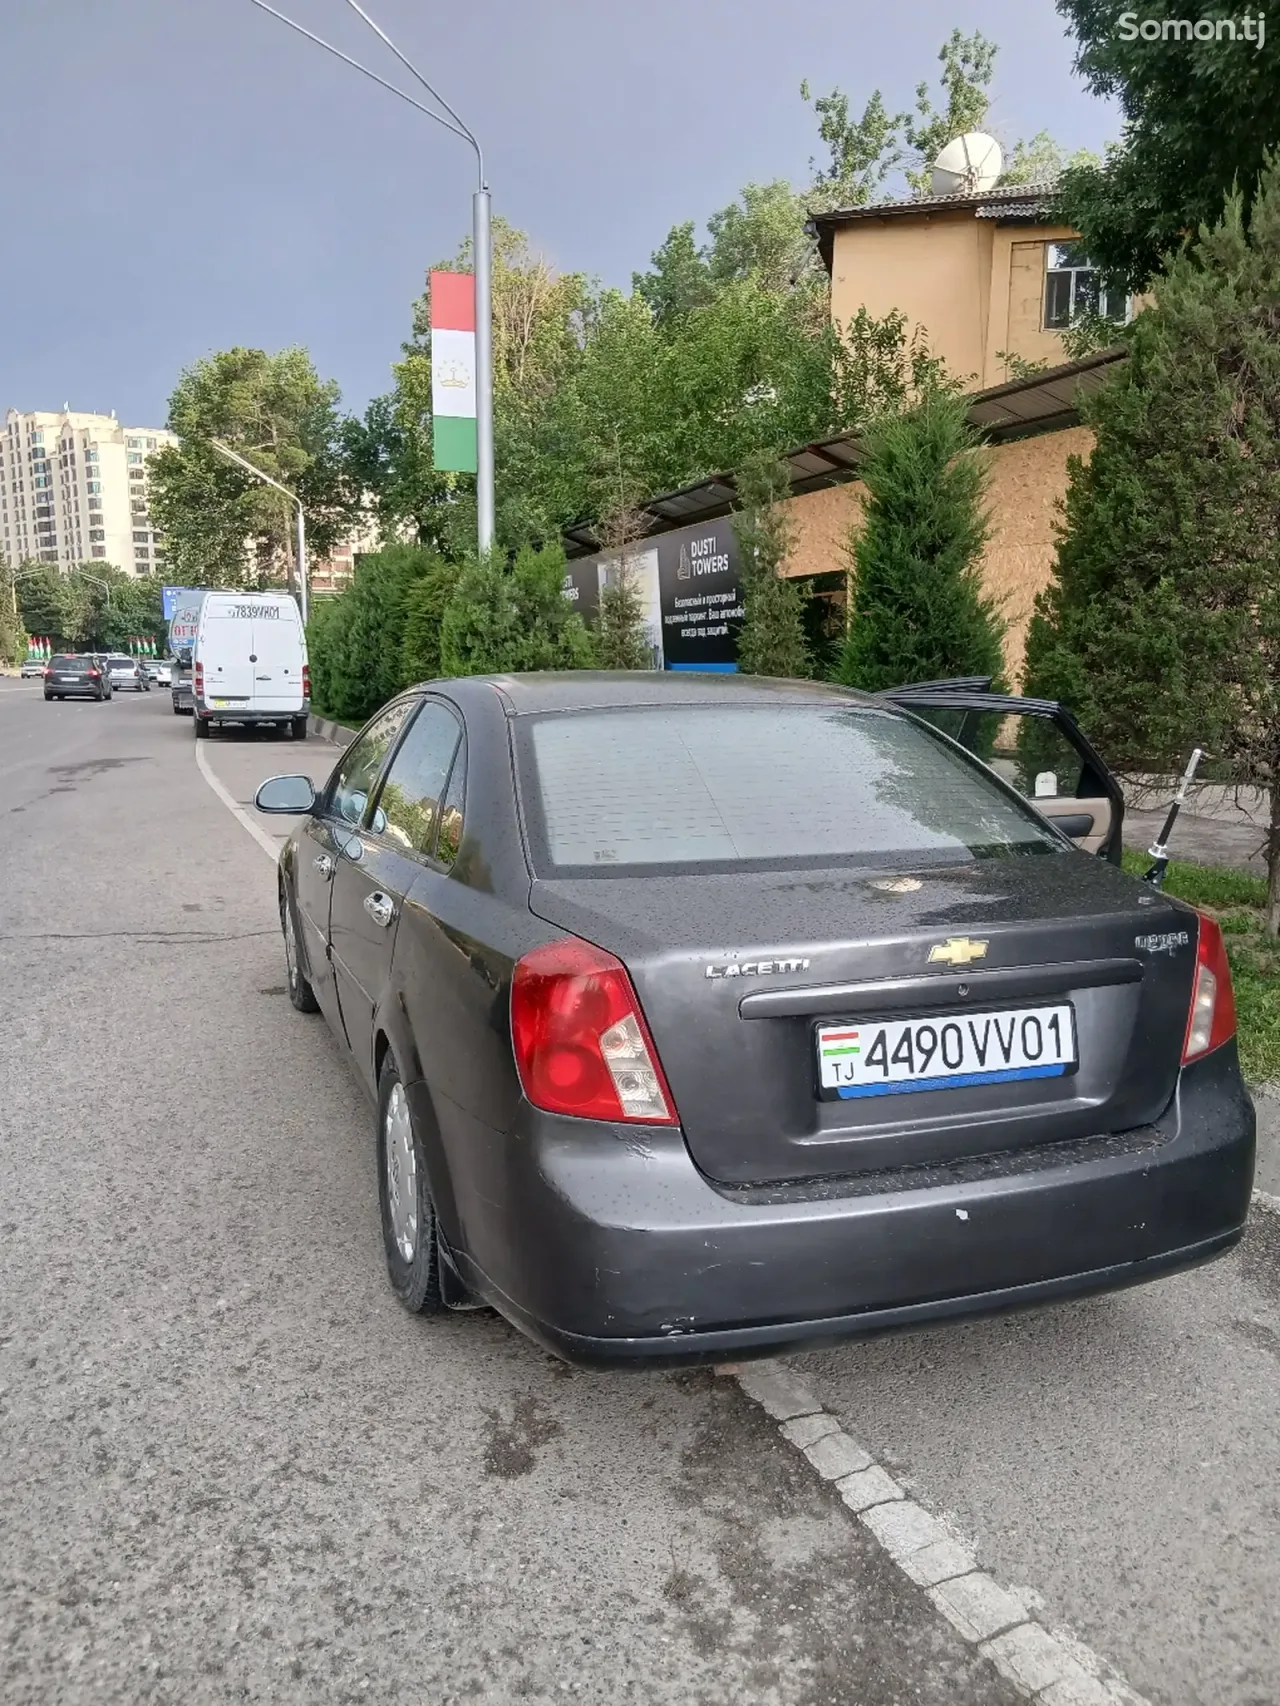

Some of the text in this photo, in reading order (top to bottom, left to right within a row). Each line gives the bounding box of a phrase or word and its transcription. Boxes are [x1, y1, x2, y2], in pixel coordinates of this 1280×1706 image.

[691, 536, 716, 557] DUSTI
[691, 553, 729, 576] TOWERS
[708, 608, 720, 620] Ваш
[705, 958, 811, 979] LACETTI
[832, 1062, 854, 1082] TJ
[864, 1013, 1061, 1077] 4490VV01
